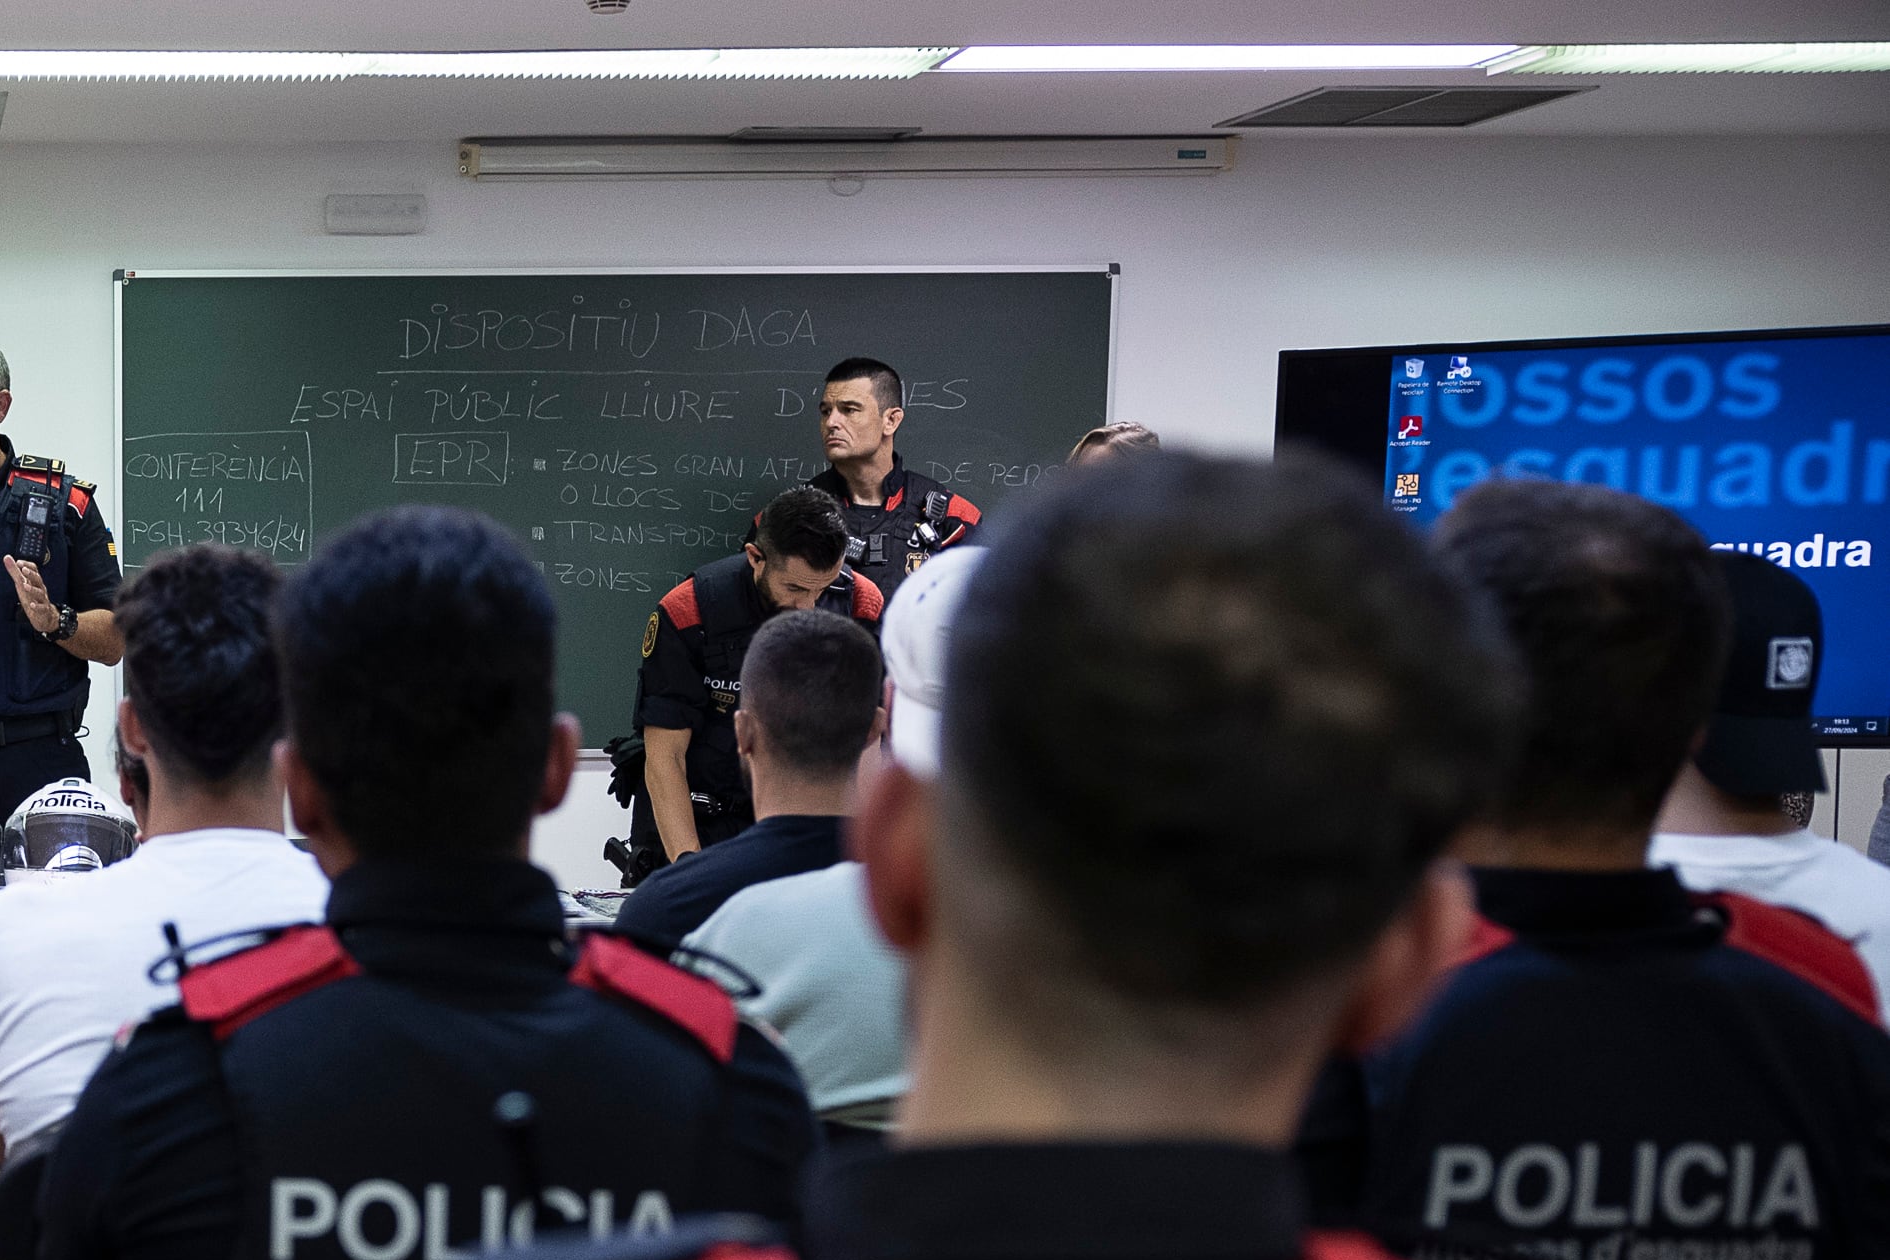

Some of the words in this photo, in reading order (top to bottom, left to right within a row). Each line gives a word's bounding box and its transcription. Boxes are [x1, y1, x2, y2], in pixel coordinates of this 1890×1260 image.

[398, 295, 660, 360] DISPOSITIU
[693, 305, 817, 353] DAGA
[290, 379, 399, 424] ESPAI
[600, 380, 740, 422] LLIURE
[125, 443, 305, 483] CONFERÈNCIA
[556, 448, 658, 477] ZONES
[673, 453, 744, 478] GRAN
[925, 460, 973, 485] DE
[175, 487, 224, 514] 111
[702, 489, 755, 513] DE
[554, 563, 652, 593] ZONES
[703, 675, 742, 691] POLIC
[29, 794, 106, 812] policia
[1423, 1140, 1821, 1231] POLICIA
